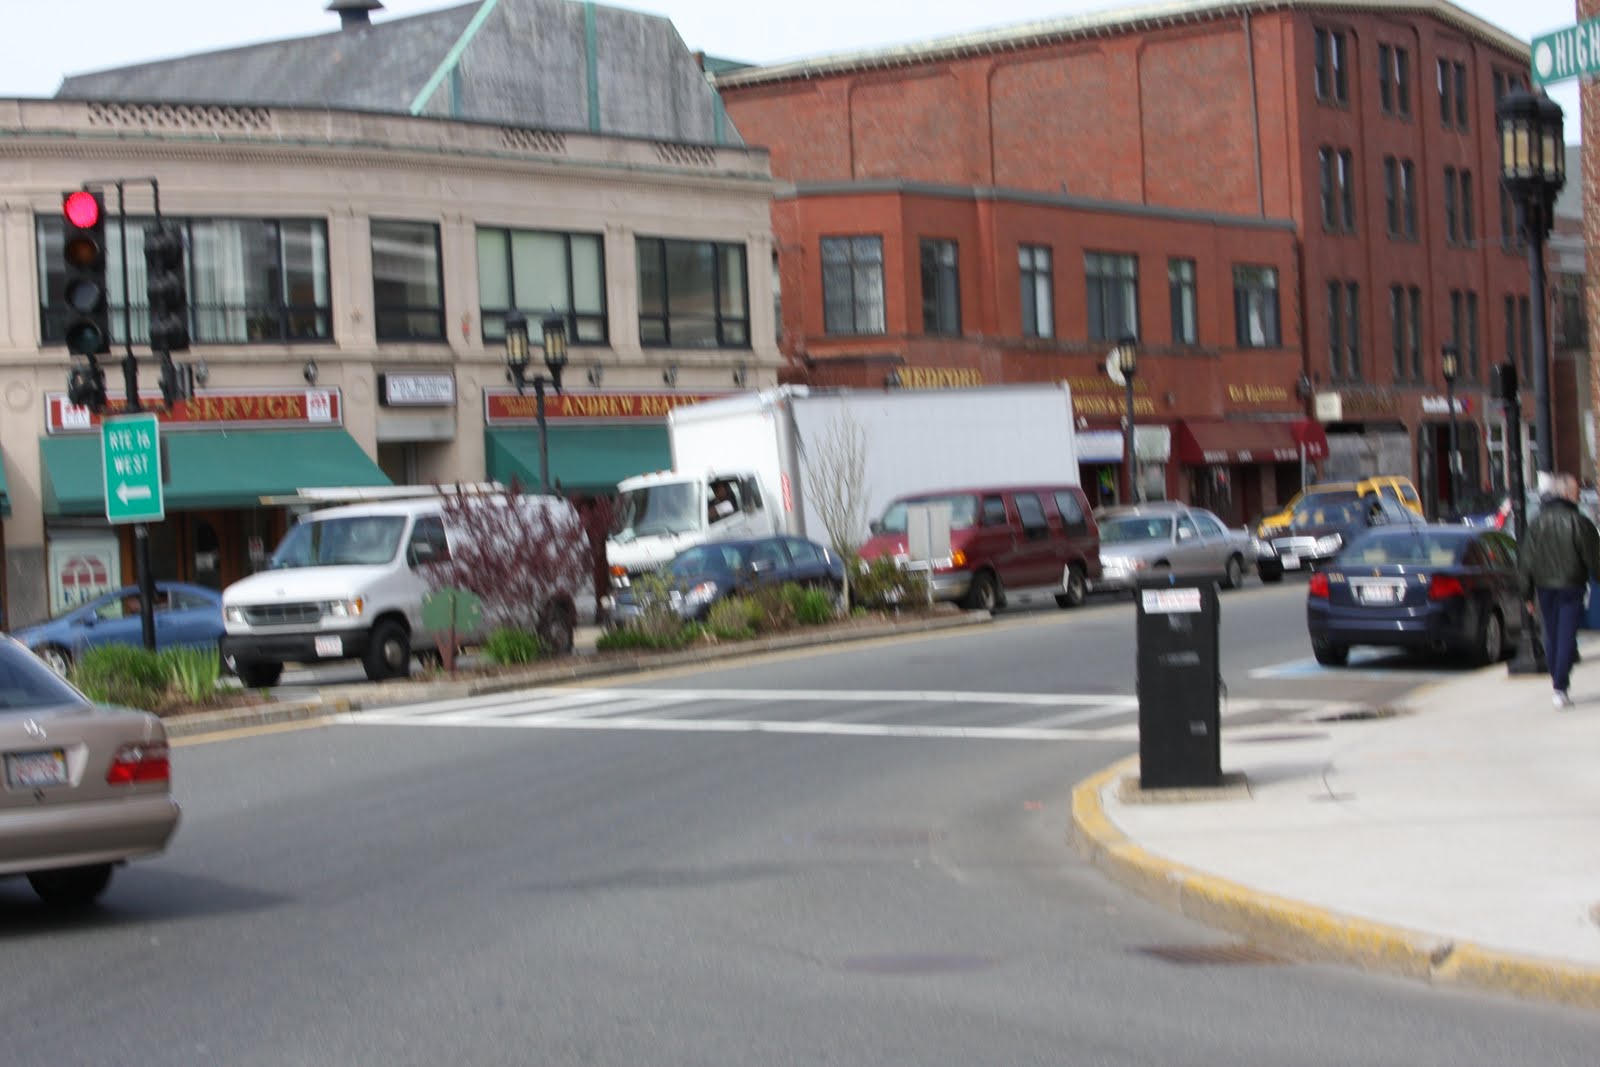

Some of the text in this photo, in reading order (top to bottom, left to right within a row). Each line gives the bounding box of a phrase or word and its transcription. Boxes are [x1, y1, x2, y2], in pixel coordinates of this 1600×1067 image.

[185, 395, 301, 420] SERVICE
[562, 394, 633, 417] ANDREW
[113, 452, 149, 476] WEST
